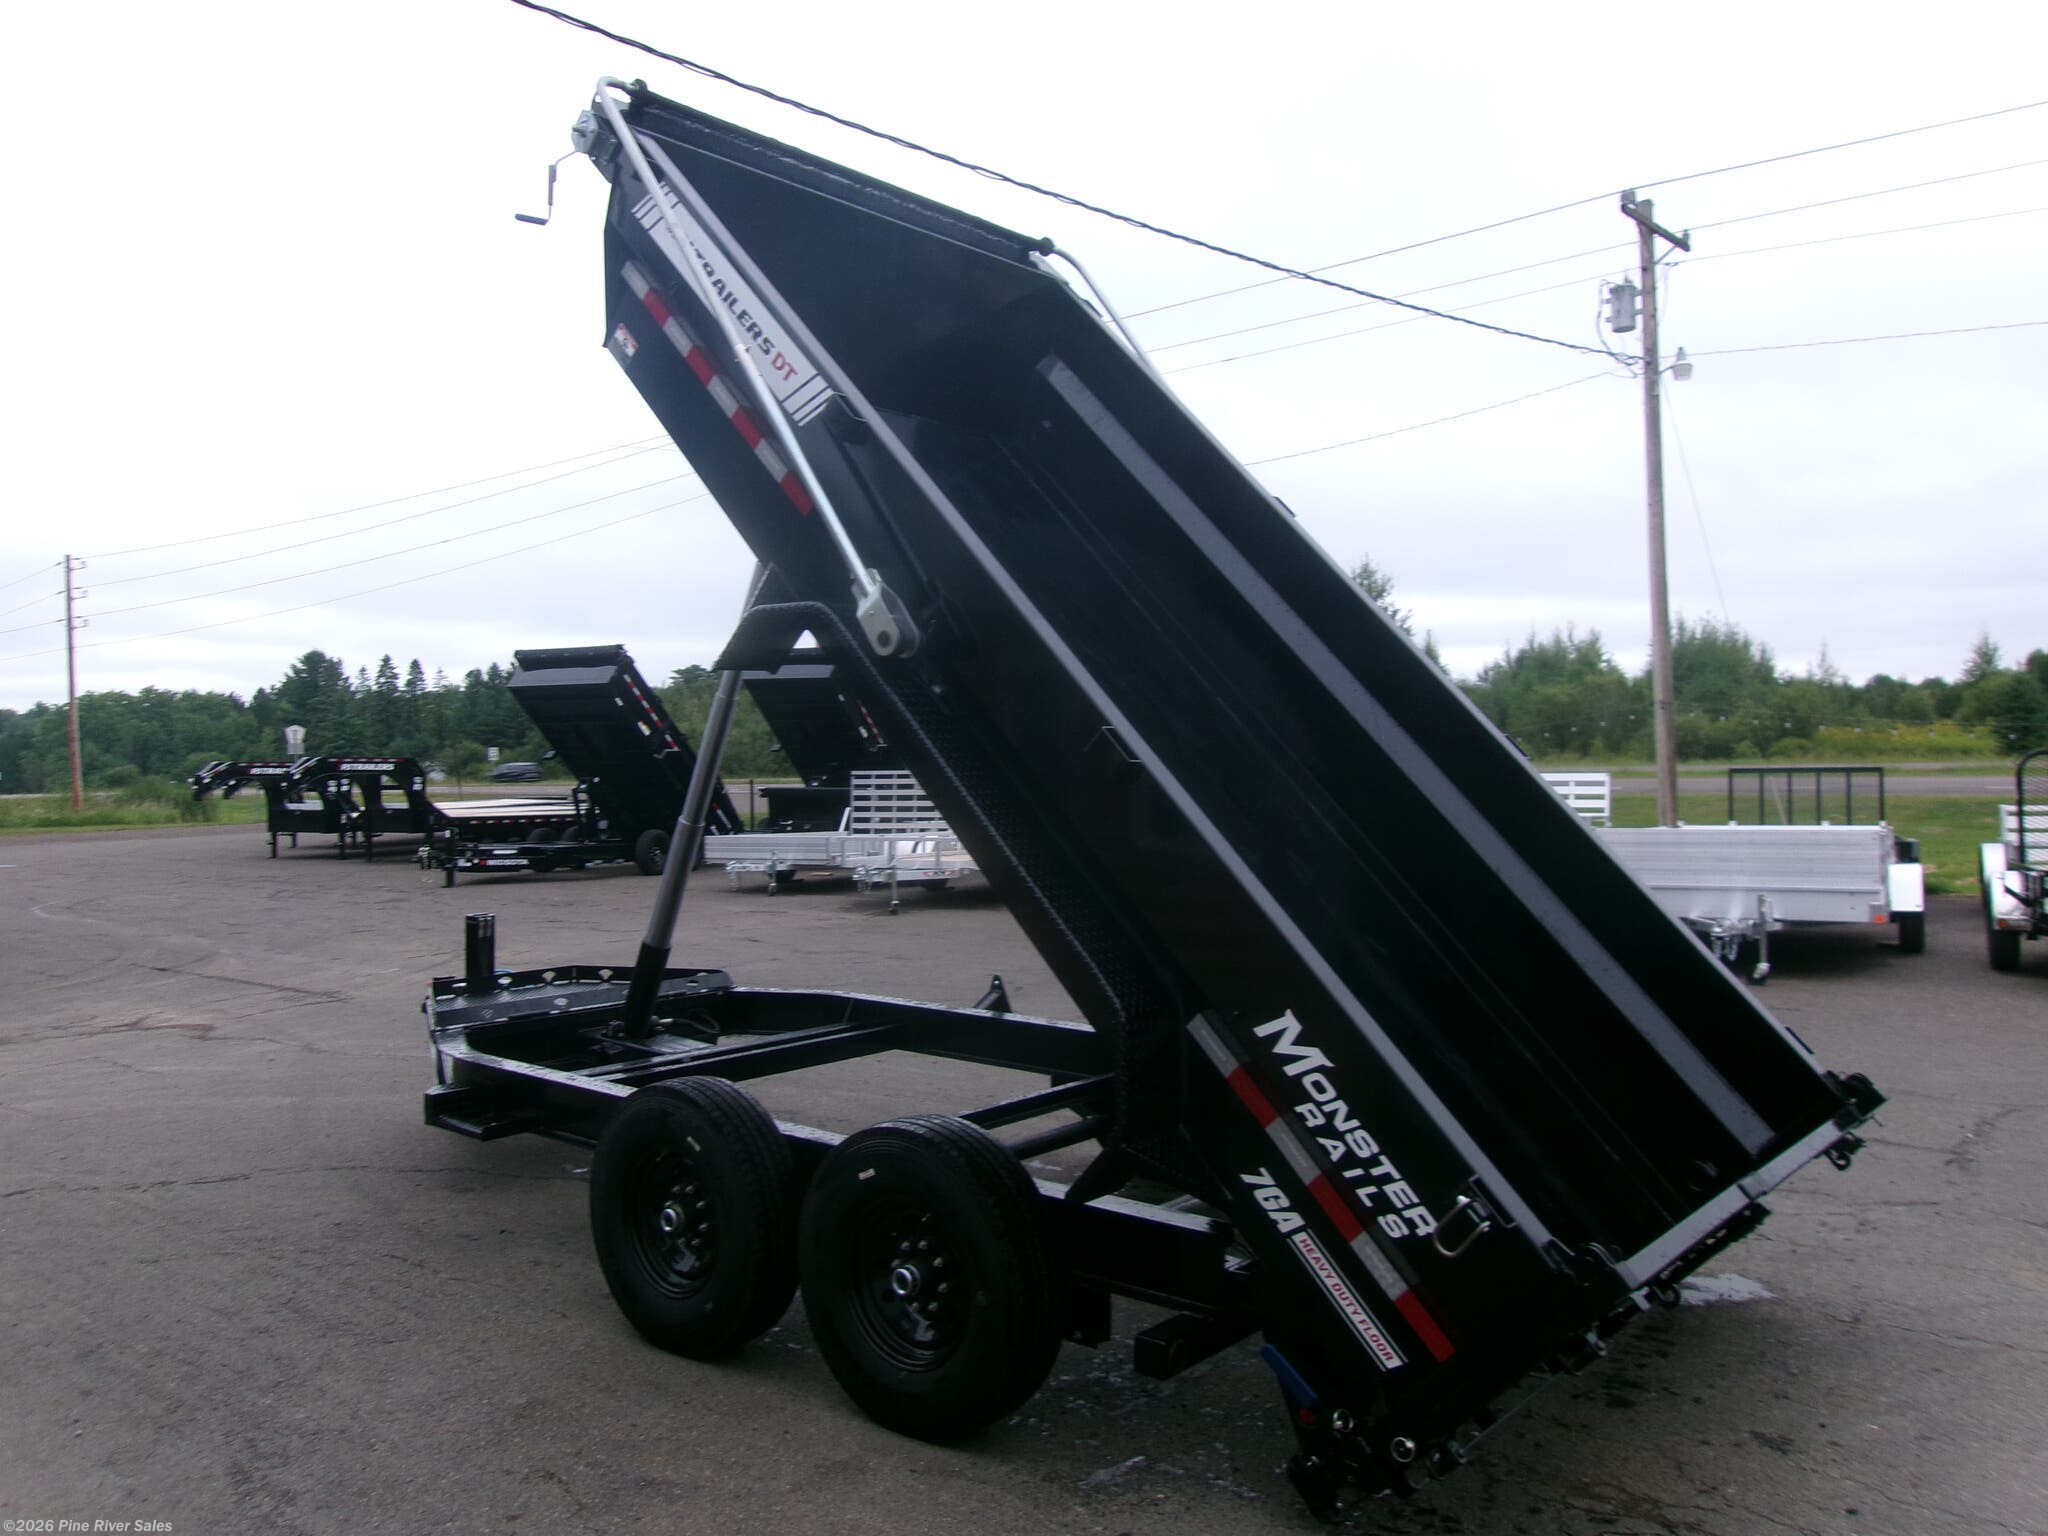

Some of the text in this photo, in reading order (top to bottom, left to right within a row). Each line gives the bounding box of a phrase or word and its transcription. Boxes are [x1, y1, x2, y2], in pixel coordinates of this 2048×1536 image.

[772, 352, 798, 380] DT
[1253, 1009, 1437, 1236] MONSTER
[1294, 1103, 1409, 1238] RAILS
[1239, 1167, 1394, 1361] 7GA HEAVY DUTY FLOOR
